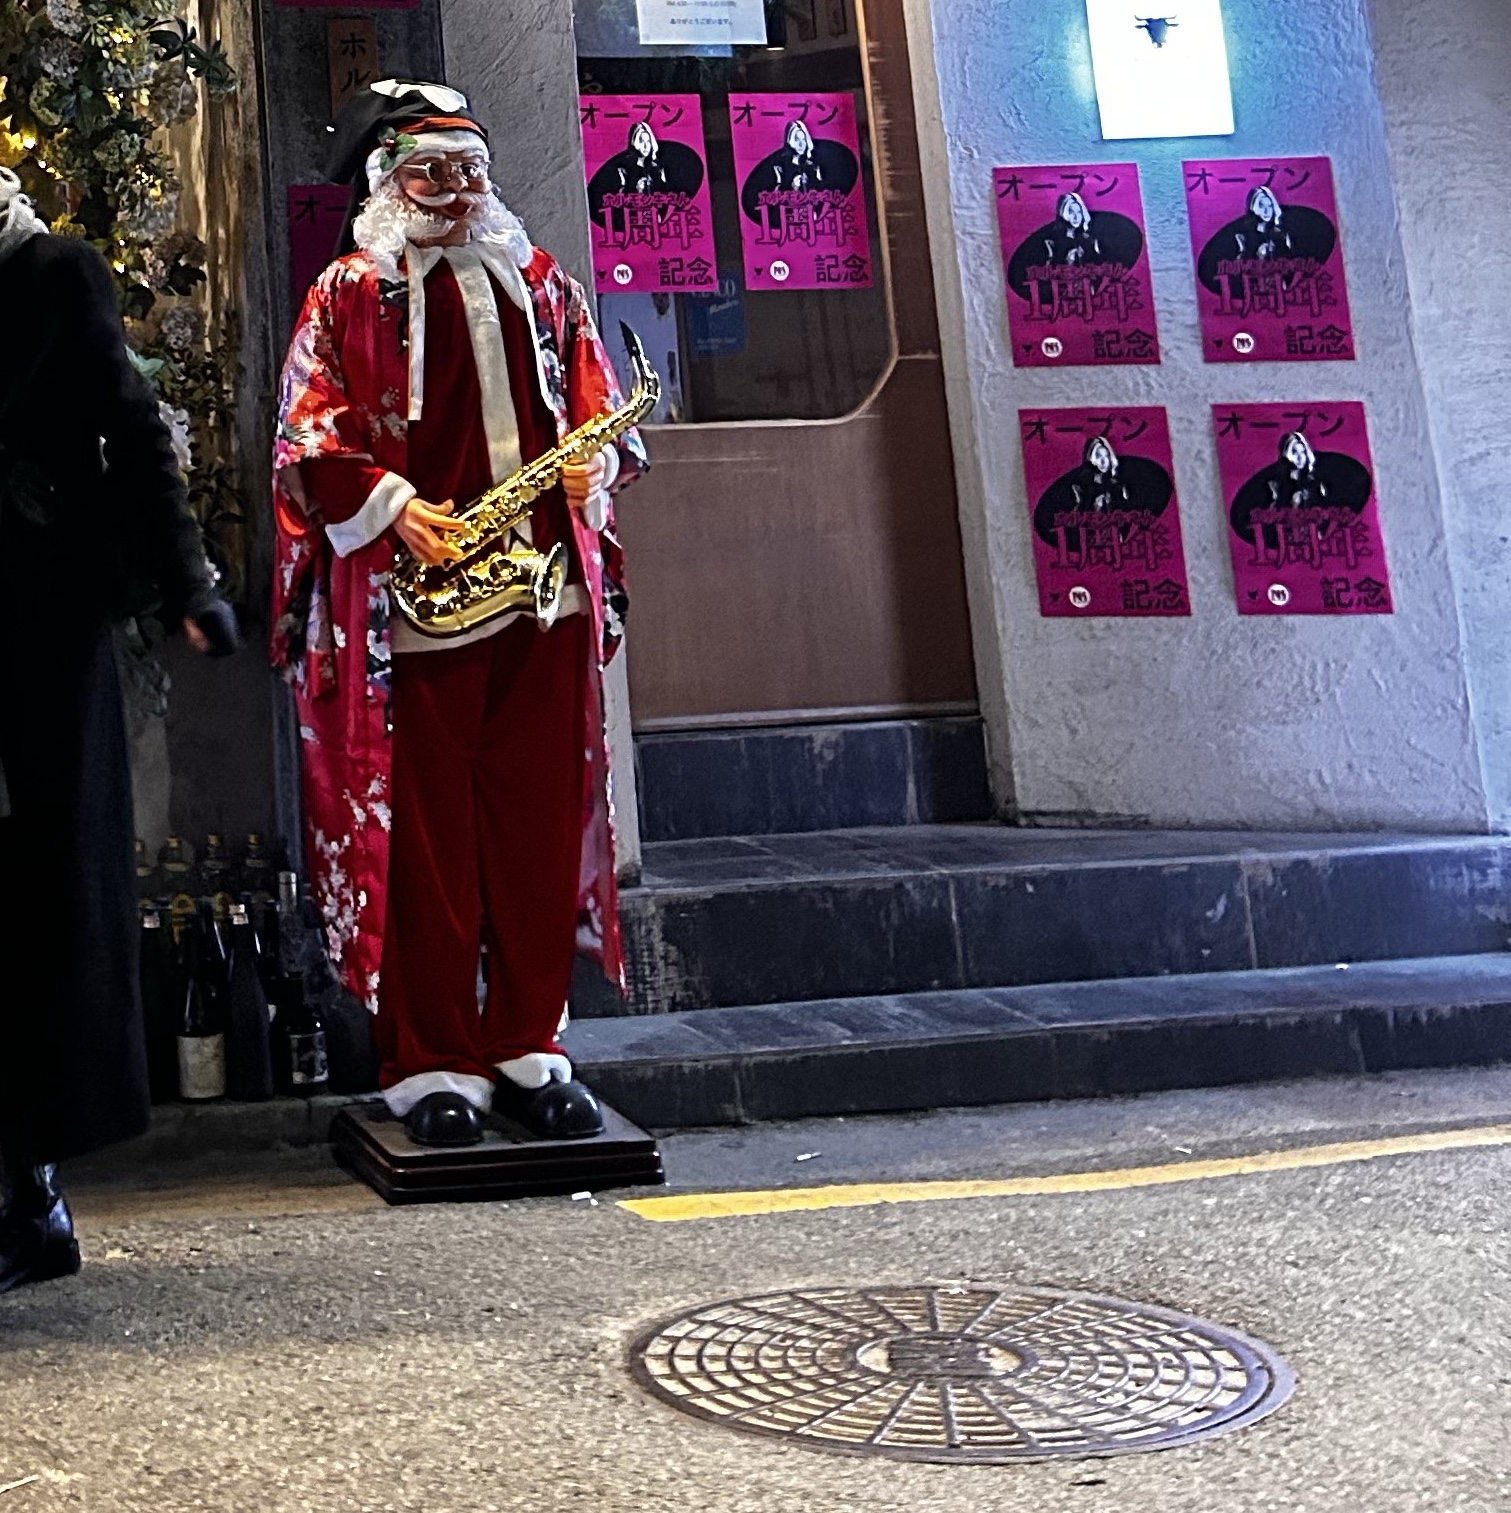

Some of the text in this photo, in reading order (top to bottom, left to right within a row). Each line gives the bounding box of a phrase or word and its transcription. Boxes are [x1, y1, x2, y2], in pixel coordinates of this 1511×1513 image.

[580, 101, 684, 130] オープン
[733, 100, 839, 128] オープン
[997, 169, 1120, 201] オープン
[1187, 162, 1311, 194] オープン
[657, 256, 714, 287] 記念
[814, 253, 869, 283] 記念
[1092, 329, 1156, 359] 記念
[1284, 324, 1349, 355] 記念
[1022, 411, 1148, 444] オープン
[1216, 410, 1345, 438] オープン
[1120, 577, 1186, 611] 記念
[1320, 576, 1389, 610] 記念
